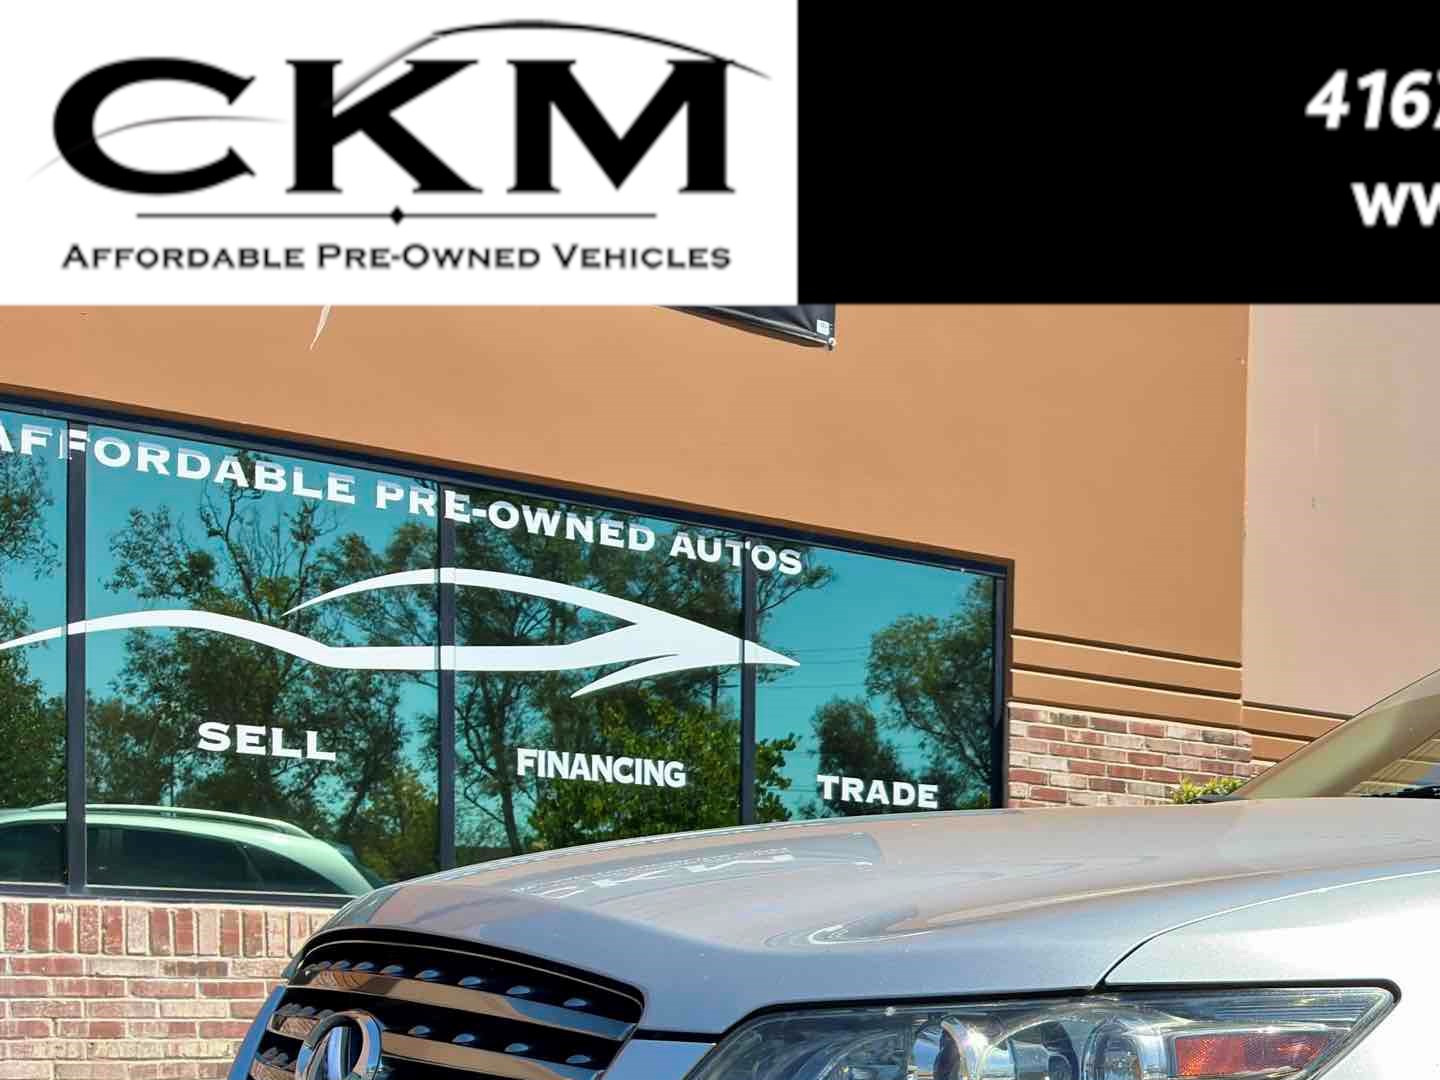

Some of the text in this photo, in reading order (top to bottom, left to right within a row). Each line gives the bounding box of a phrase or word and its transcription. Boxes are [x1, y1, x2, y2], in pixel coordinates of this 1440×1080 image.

[375, 480, 656, 552] PRE-OWNED
[669, 530, 803, 577] AUTOS
[197, 721, 337, 762] SELL
[517, 747, 687, 788] FINANCING
[816, 774, 939, 811] TRADE
